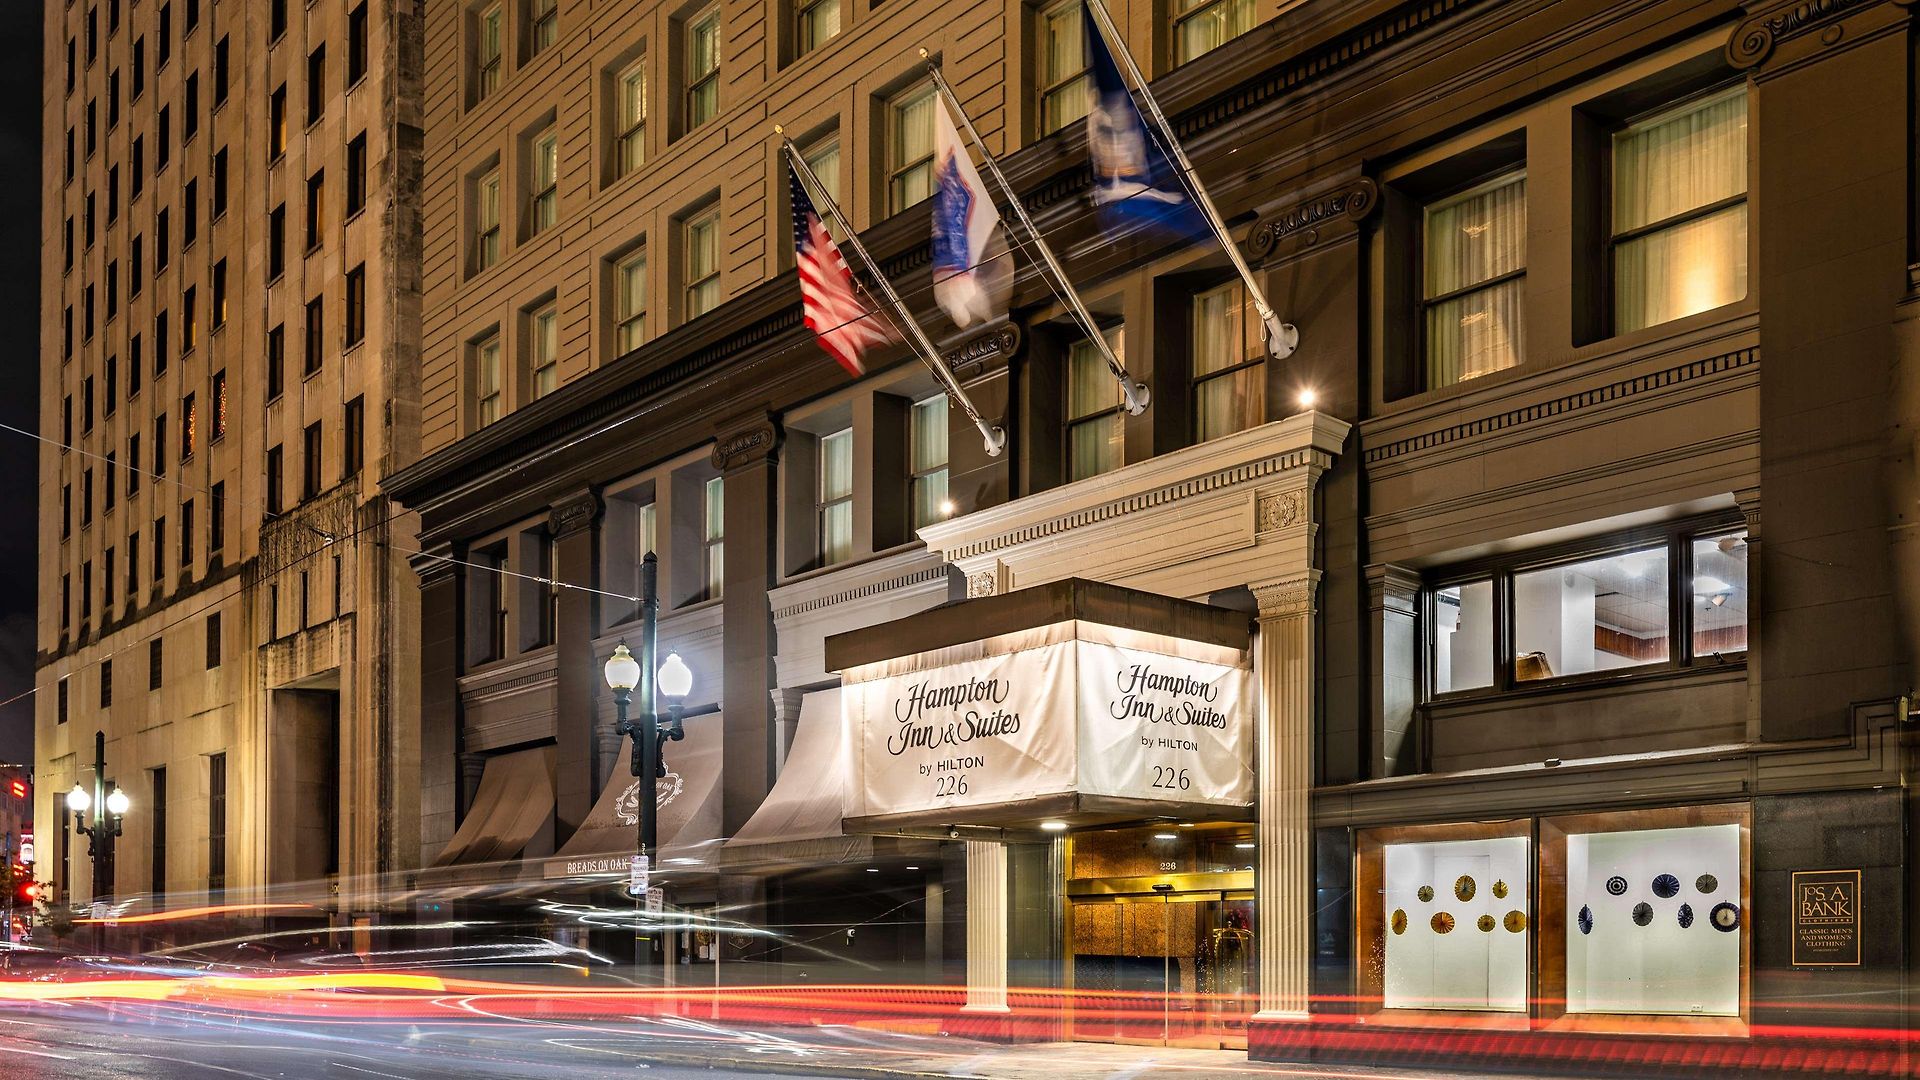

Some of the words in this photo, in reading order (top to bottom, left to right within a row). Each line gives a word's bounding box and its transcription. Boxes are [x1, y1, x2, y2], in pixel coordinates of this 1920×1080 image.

[1117, 664, 1217, 702] Hampton
[895, 676, 1010, 723] Hampton
[1110, 695, 1164, 724] Inn
[1164, 706, 1177, 726] &
[1176, 701, 1226, 729] Suites
[887, 722, 943, 755] Inn
[944, 723, 958, 745] &
[957, 709, 1020, 742] Suites
[1141, 736, 1154, 748] by
[1158, 738, 1198, 751] HILTON
[919, 763, 932, 776] by
[937, 756, 984, 772] HILTON
[935, 774, 968, 797] 226
[1152, 765, 1190, 790] 226
[567, 861, 597, 873] BREADS
[598, 860, 609, 871] ON
[610, 858, 628, 870] OAK
[1160, 862, 1177, 870] 226
[1830, 886, 1848, 900] A.
[1802, 901, 1852, 917] BANK
